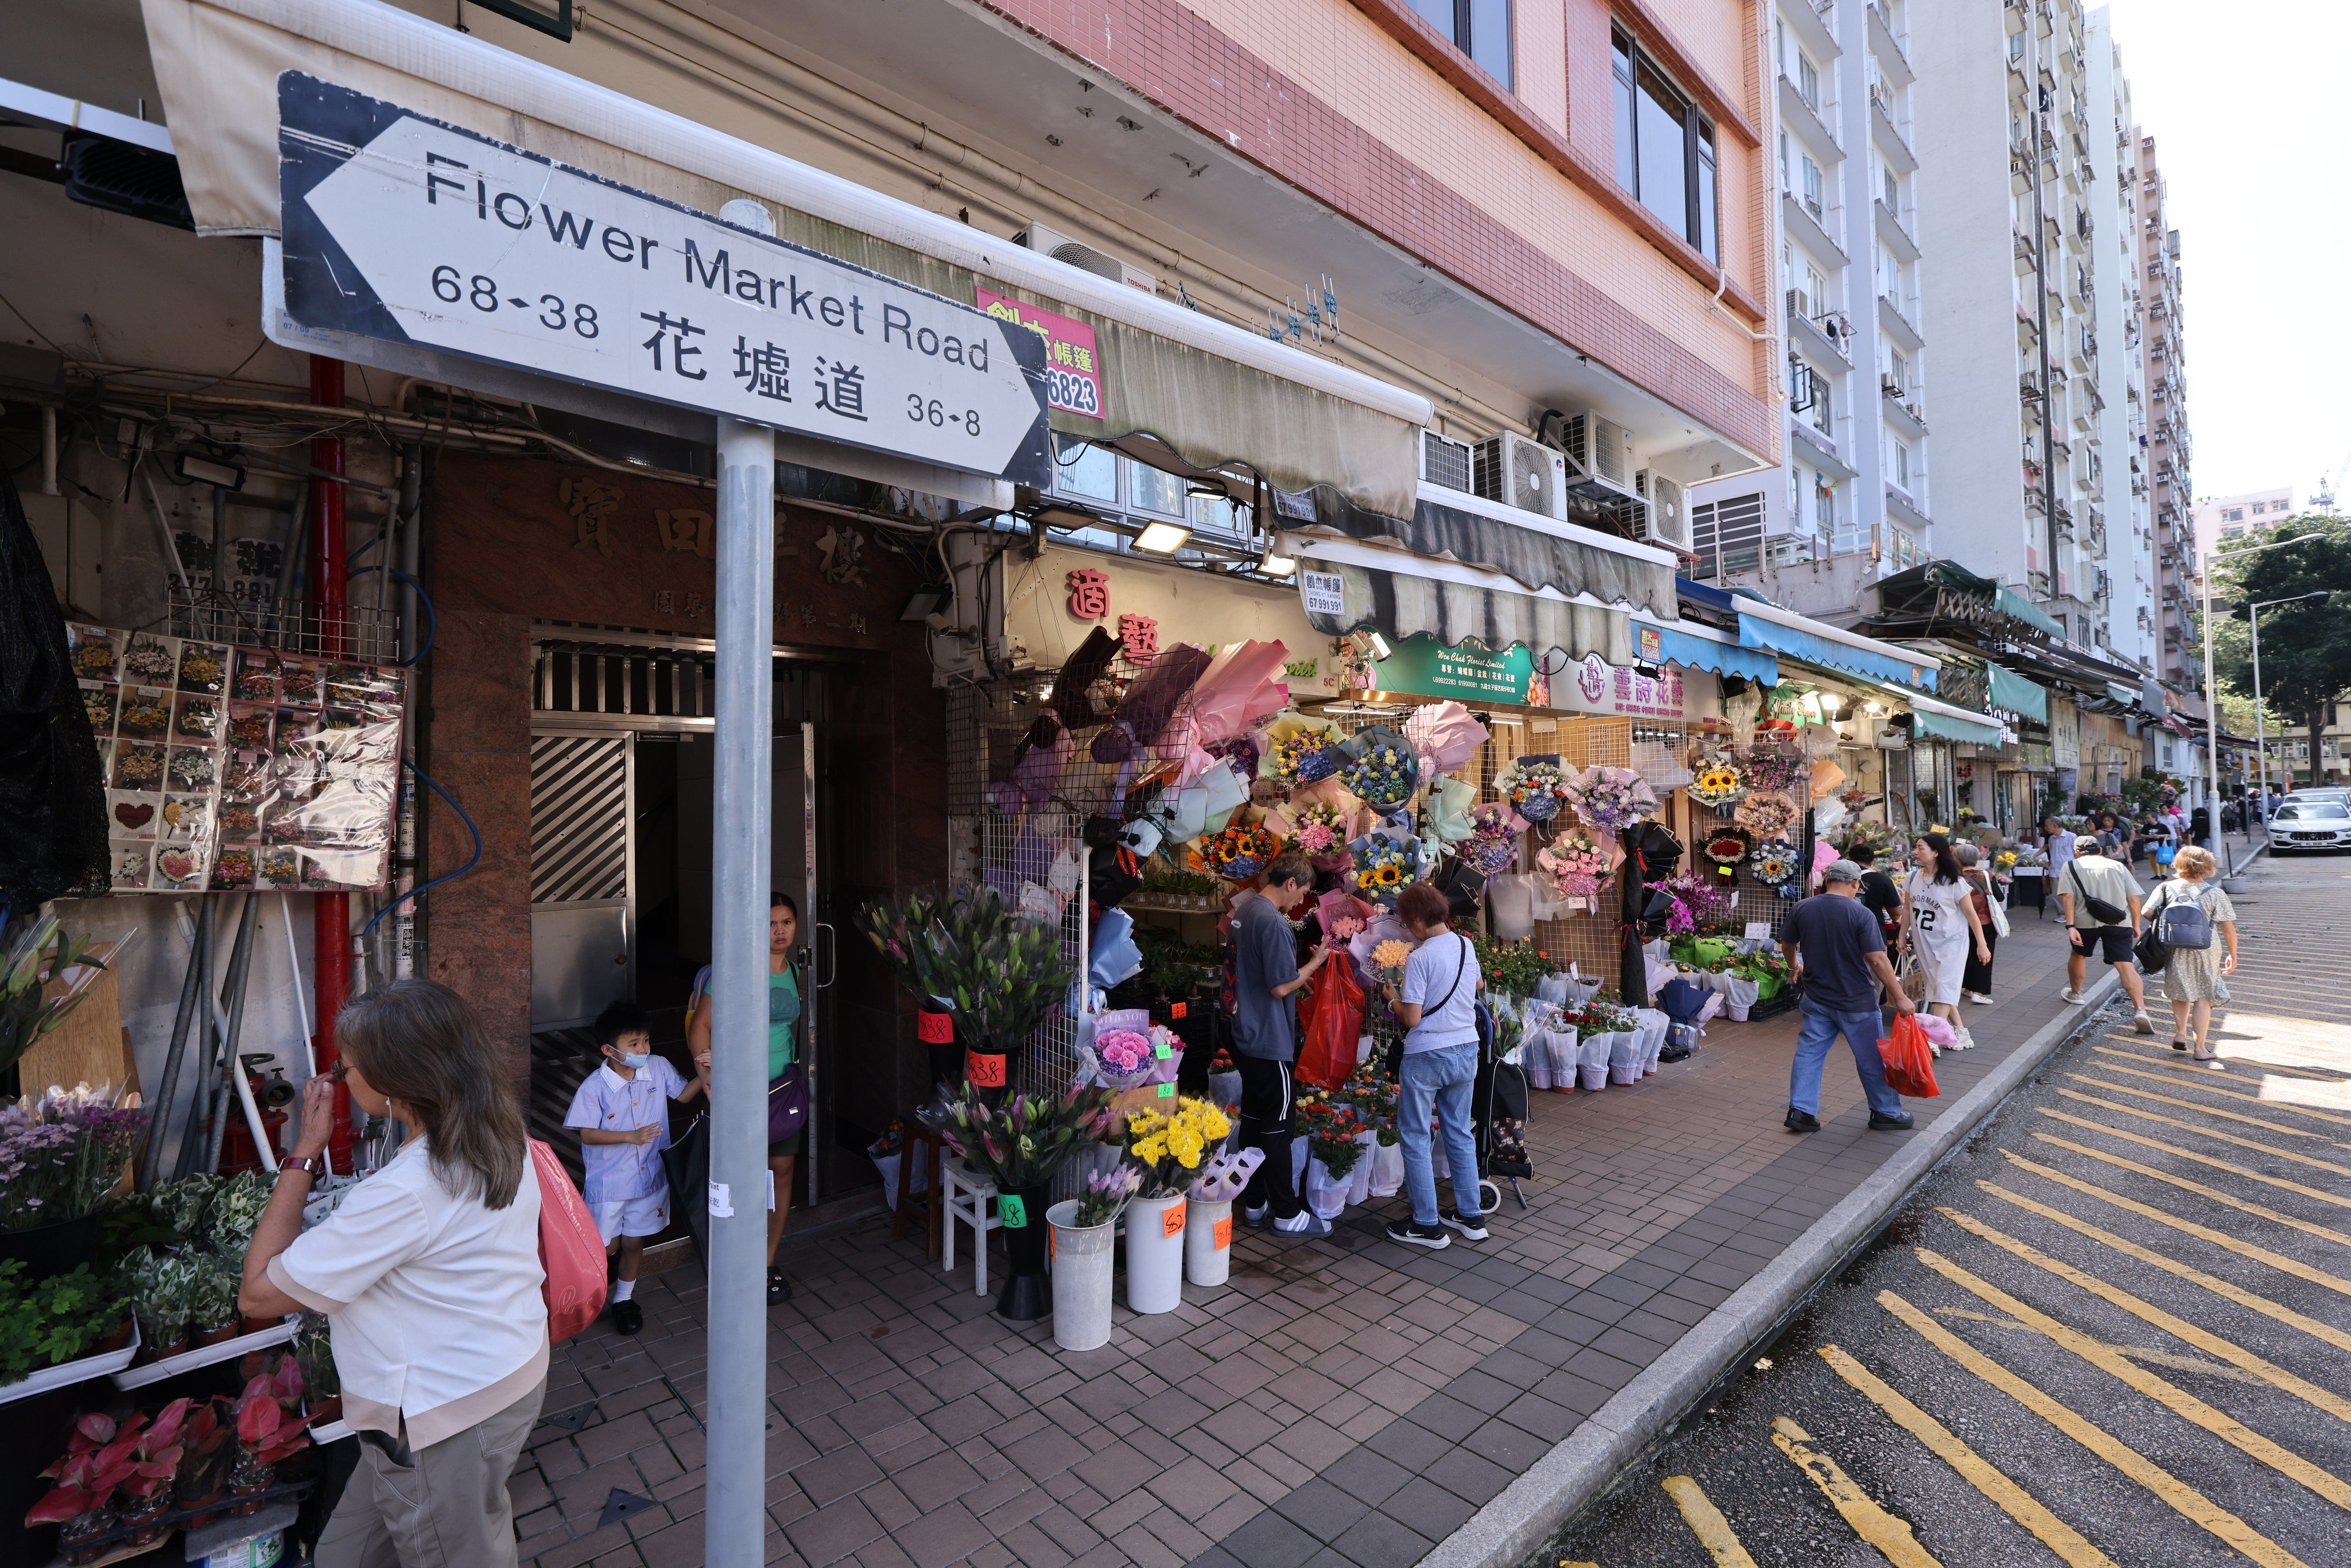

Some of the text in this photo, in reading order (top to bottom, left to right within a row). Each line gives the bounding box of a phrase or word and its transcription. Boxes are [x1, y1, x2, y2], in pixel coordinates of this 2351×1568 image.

[426, 151, 988, 374] Flower Market Road
[1127, 278, 1151, 293] TOSHIBA
[432, 265, 599, 339] 68 38
[640, 311, 868, 422] 花墟道
[907, 393, 980, 437] 36 8
[1437, 650, 1506, 669] Wen Chak Florist Limited
[1324, 677, 1335, 687] 5C
[1436, 677, 1456, 685] 69922283
[1912, 907, 1935, 931] 72
[968, 1057, 1000, 1082] $38
[1160, 1086, 1170, 1095] 180
